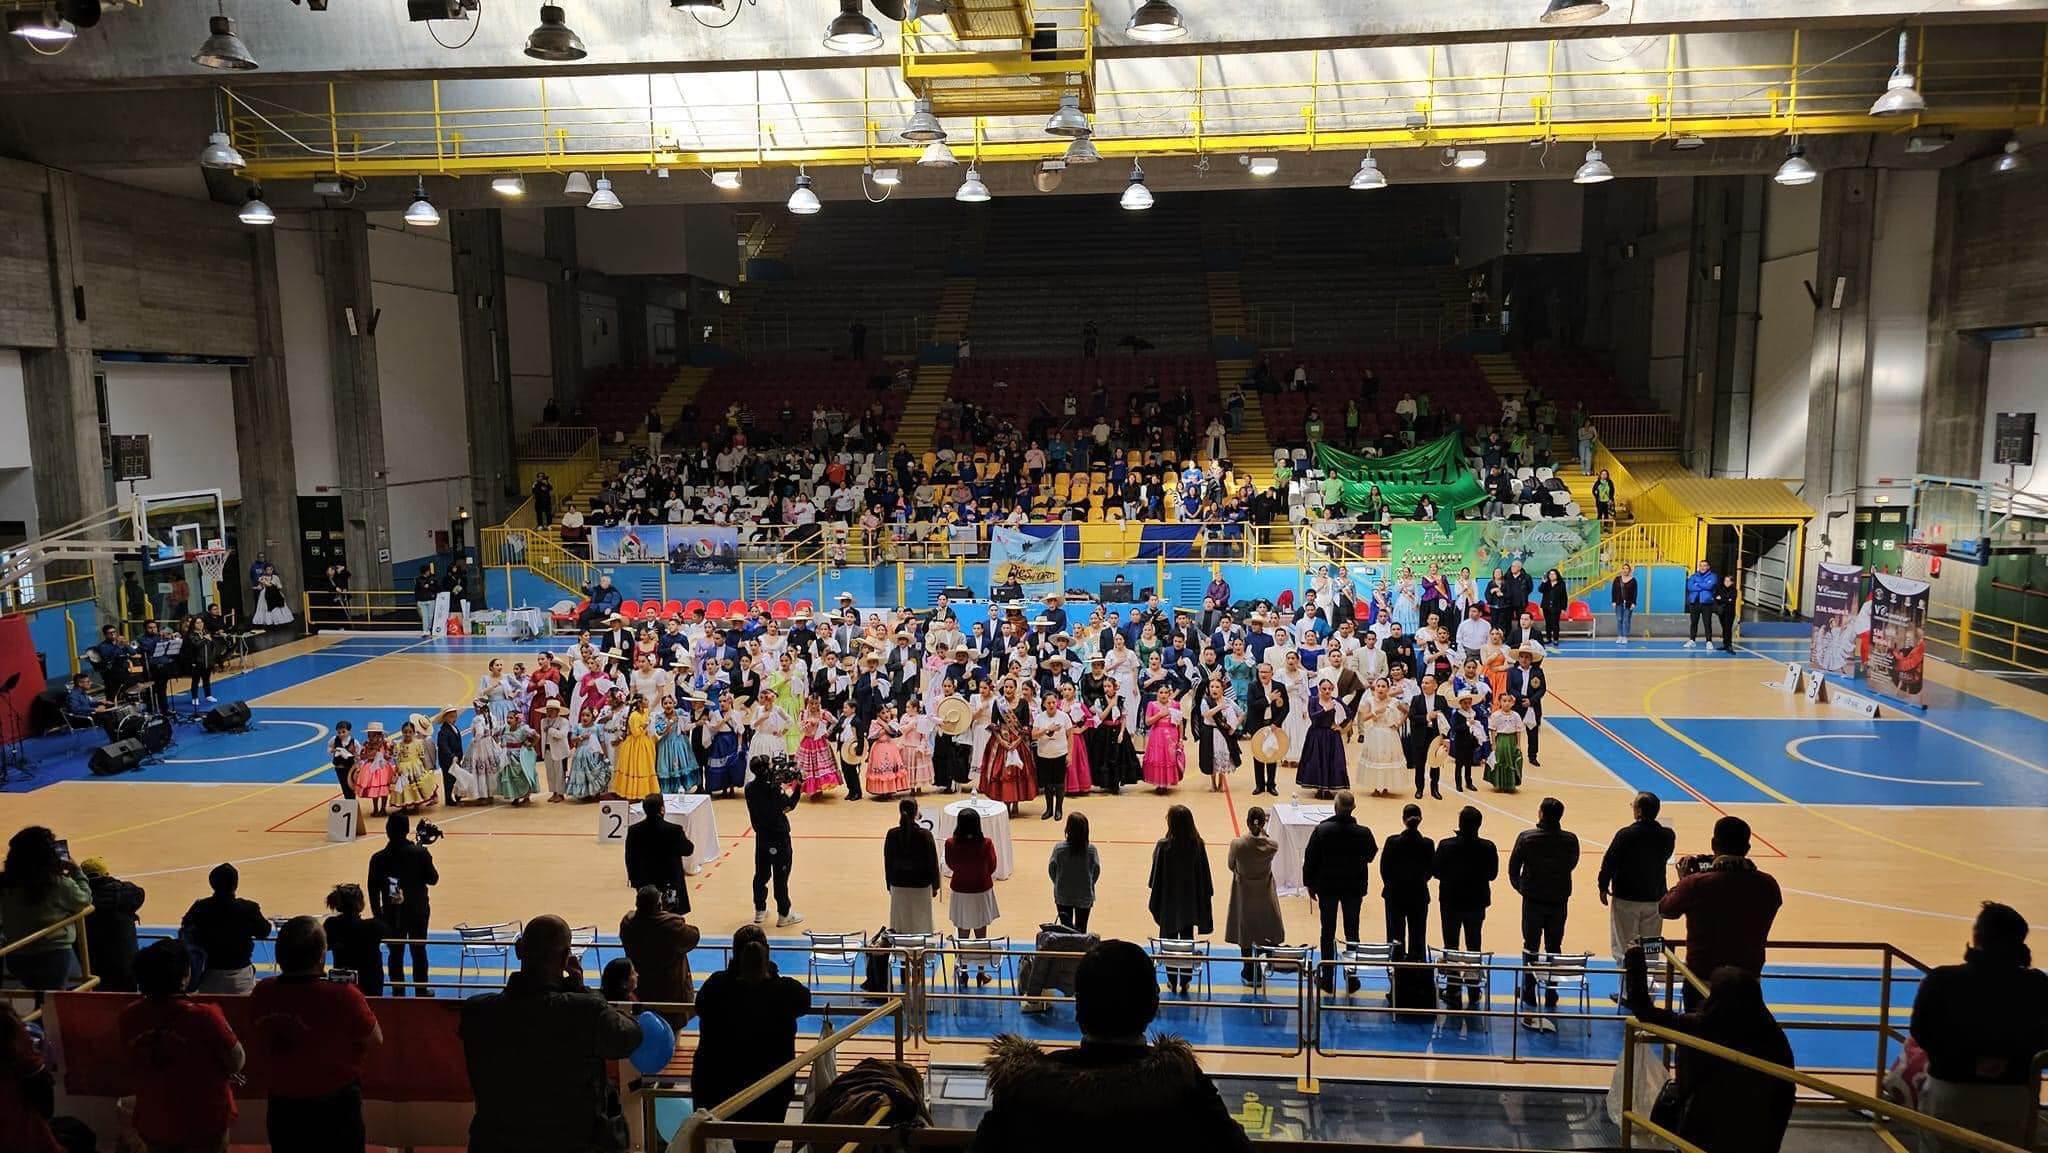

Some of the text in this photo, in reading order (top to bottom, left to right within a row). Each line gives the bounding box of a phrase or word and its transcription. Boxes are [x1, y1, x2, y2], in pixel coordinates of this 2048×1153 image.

[1809, 681, 1818, 698] 3
[341, 811, 352, 838] 1
[607, 814, 622, 839] 2
